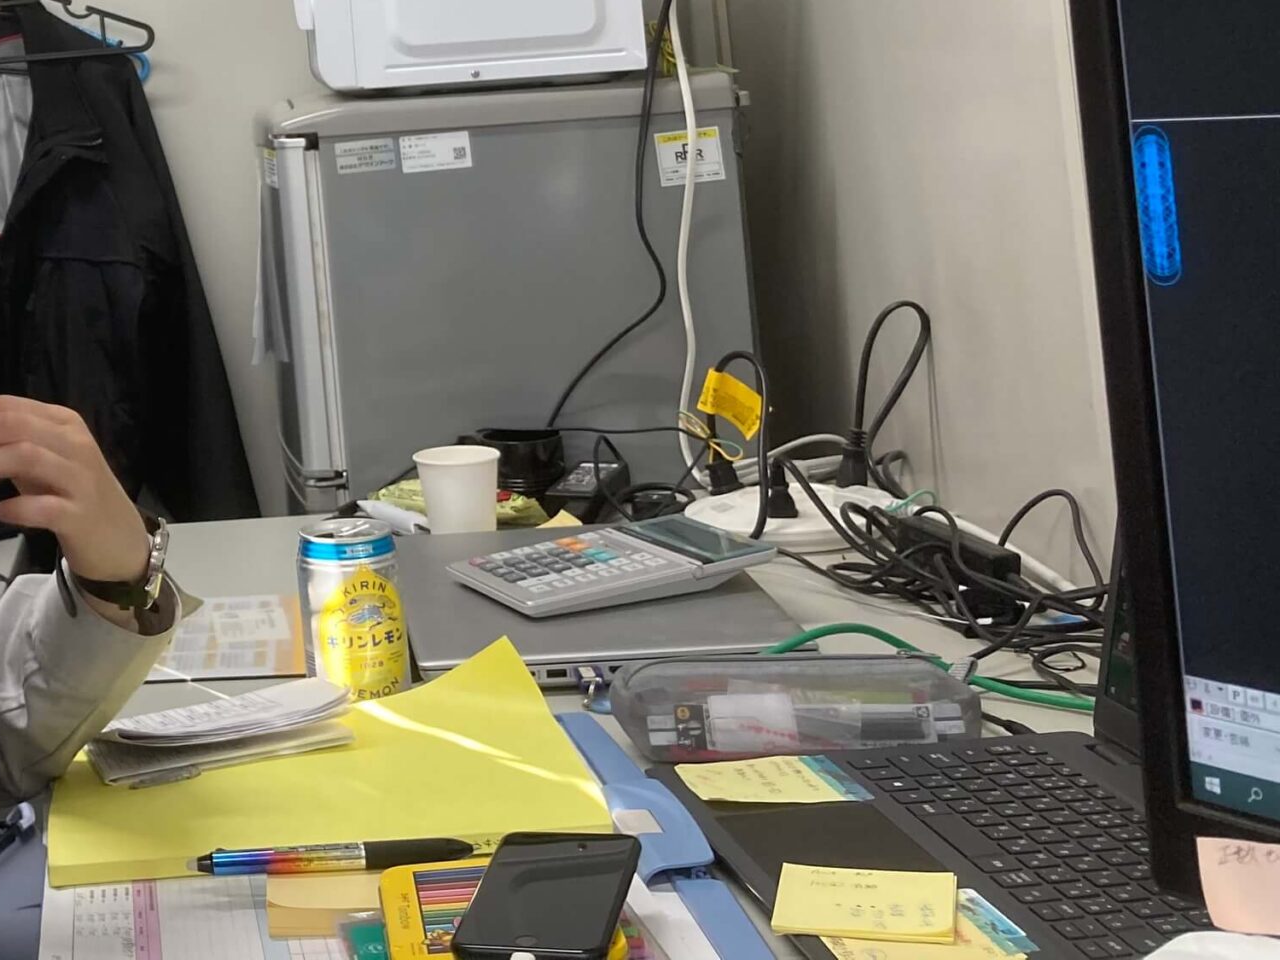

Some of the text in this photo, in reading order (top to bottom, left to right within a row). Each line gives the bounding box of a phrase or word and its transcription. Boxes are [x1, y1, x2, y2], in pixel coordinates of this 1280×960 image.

[343, 580, 388, 597] KIRIN
[328, 626, 404, 650] キリンレモン
